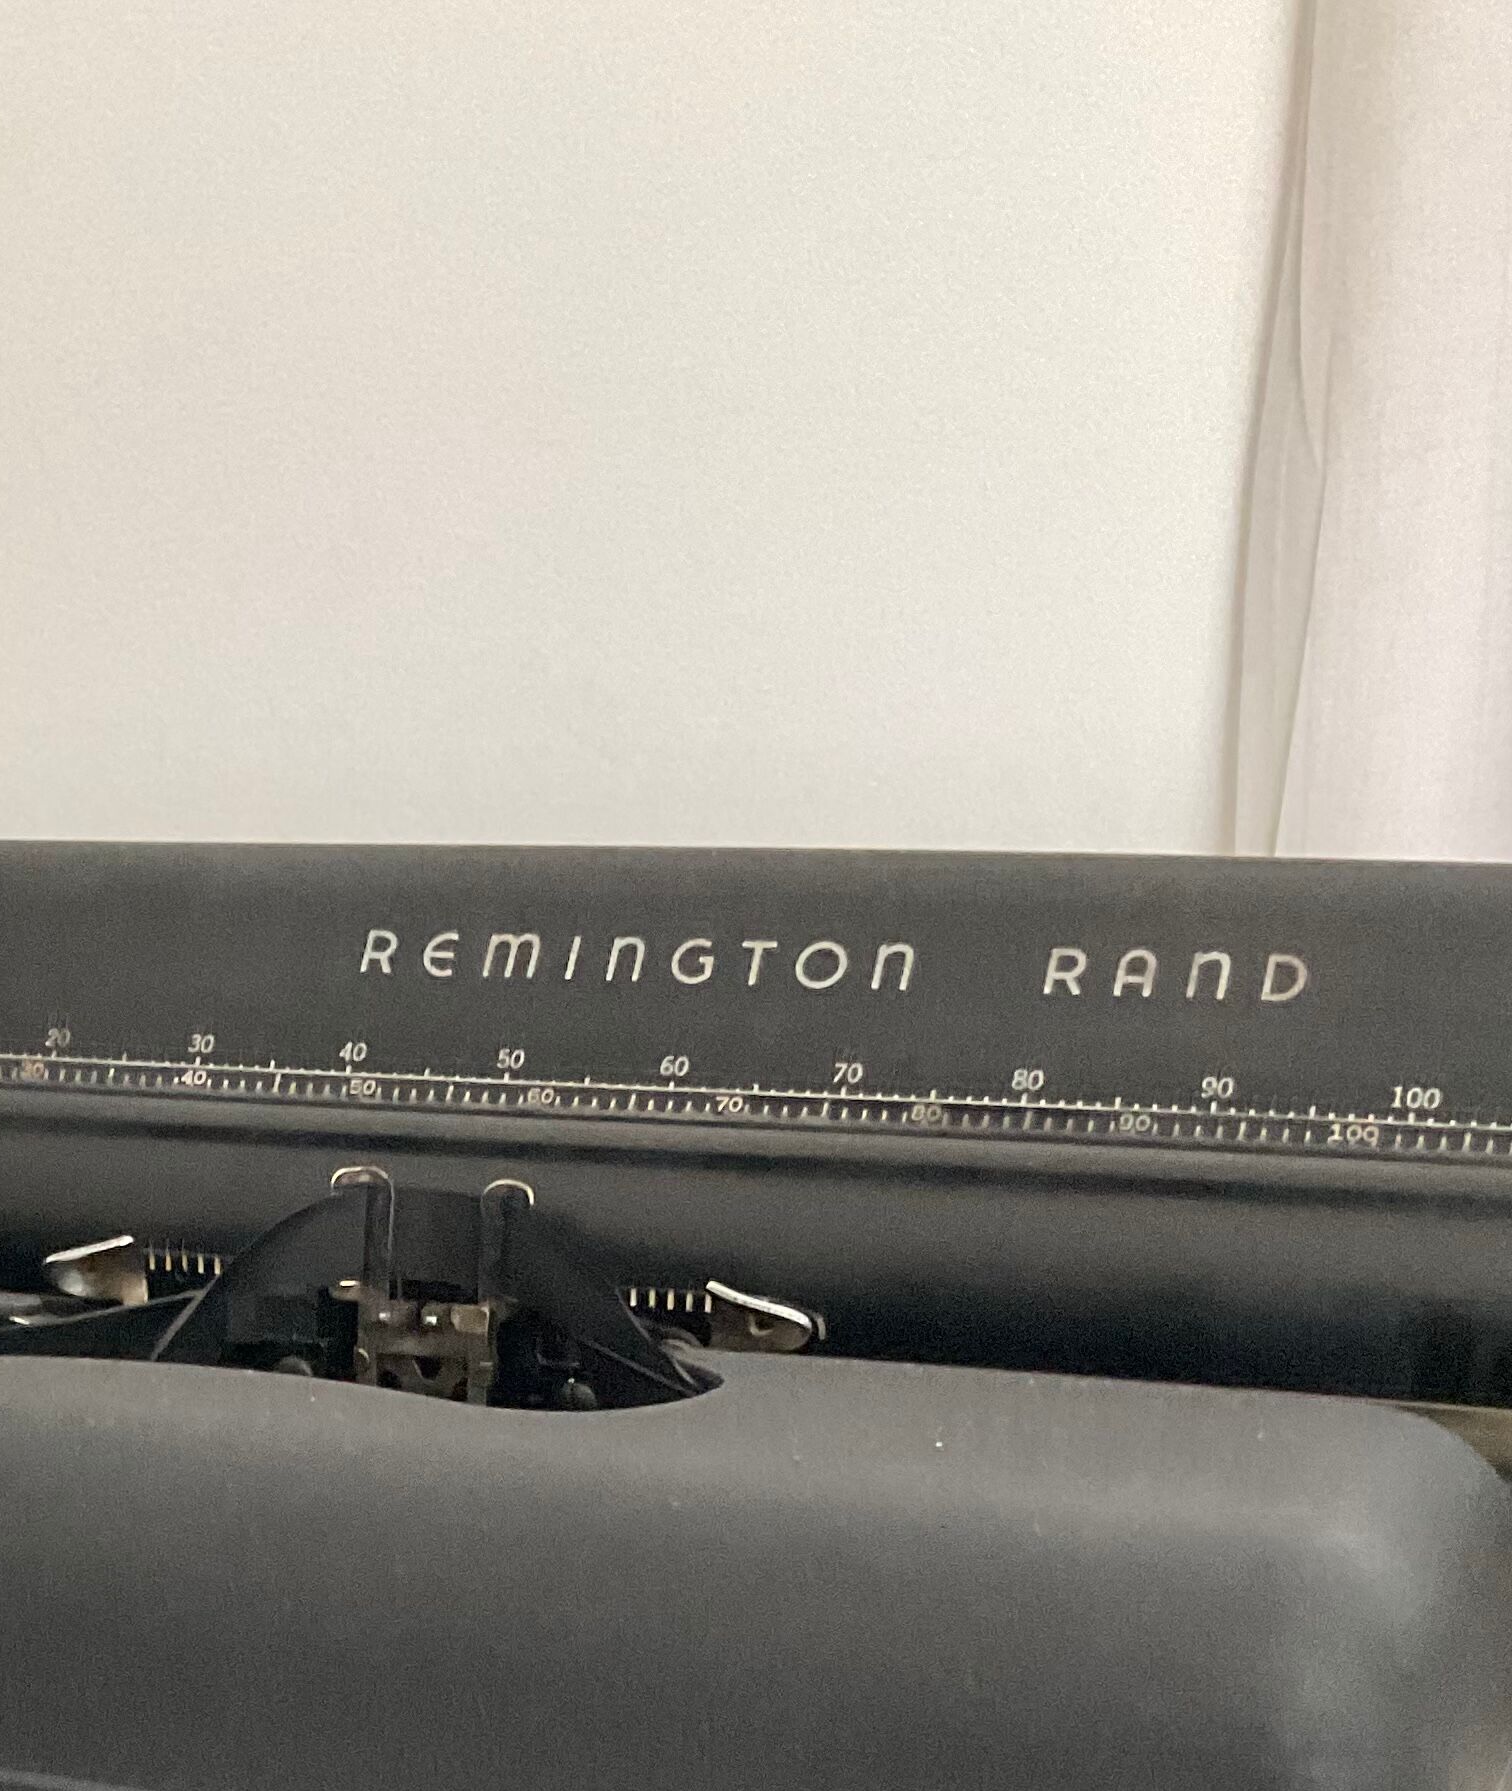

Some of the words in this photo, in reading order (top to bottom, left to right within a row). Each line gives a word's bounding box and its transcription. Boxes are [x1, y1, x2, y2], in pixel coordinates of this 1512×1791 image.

[359, 929, 915, 991] REMINGTON
[1042, 947, 1308, 1002] RAND
[45, 1027, 71, 1047] 20
[187, 1033, 215, 1054] 30
[339, 1041, 368, 1062] 40
[496, 1048, 525, 1069] 50
[659, 1055, 690, 1077] 60
[833, 1062, 864, 1084] 70
[1011, 1069, 1044, 1091] 80
[1201, 1076, 1234, 1098] 90
[1391, 1086, 1441, 1109] 100
[181, 1070, 207, 1087] 40
[350, 1080, 377, 1097] 50
[527, 1088, 555, 1105] 60
[716, 1096, 745, 1113] 70
[1119, 1114, 1153, 1132] 90
[1329, 1124, 1380, 1146] 100
